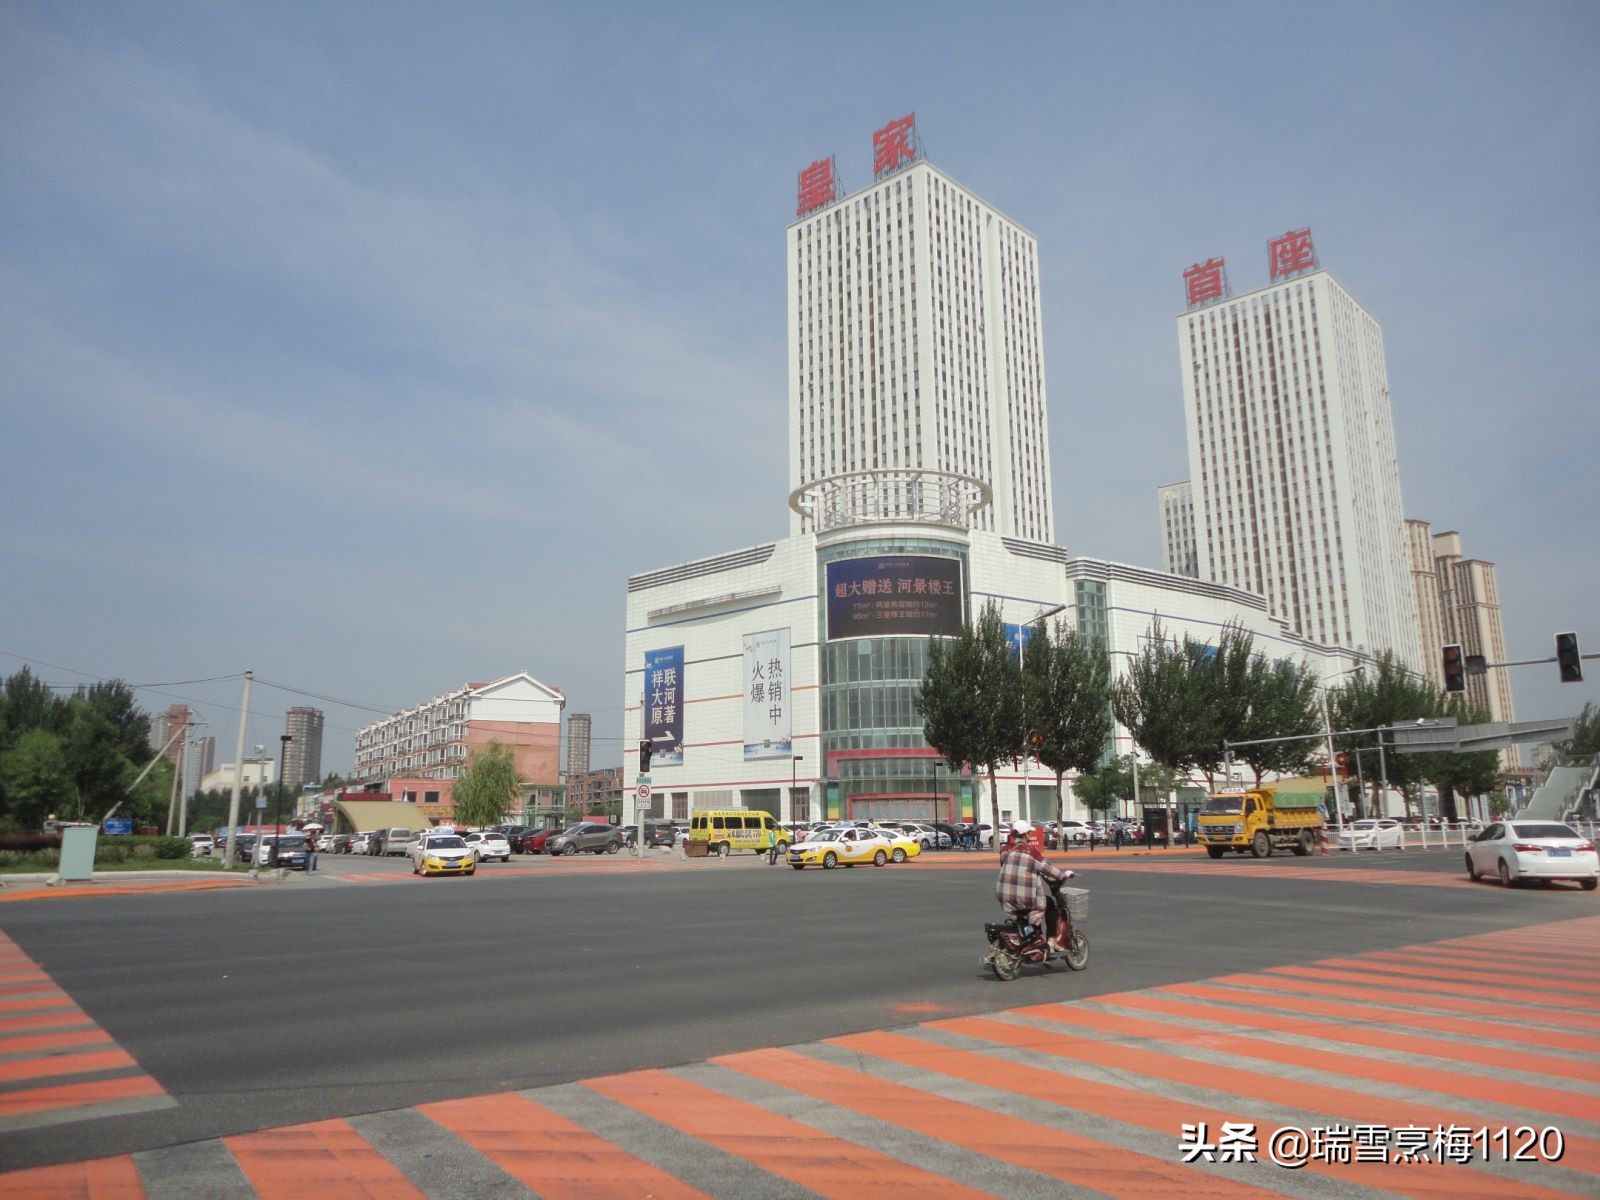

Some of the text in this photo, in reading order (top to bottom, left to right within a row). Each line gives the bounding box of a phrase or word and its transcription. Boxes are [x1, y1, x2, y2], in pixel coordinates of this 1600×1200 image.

[835, 578, 954, 598] 超大赠送 河景楼王
[750, 660, 765, 703] 火爆
[768, 657, 783, 725] 热销中
